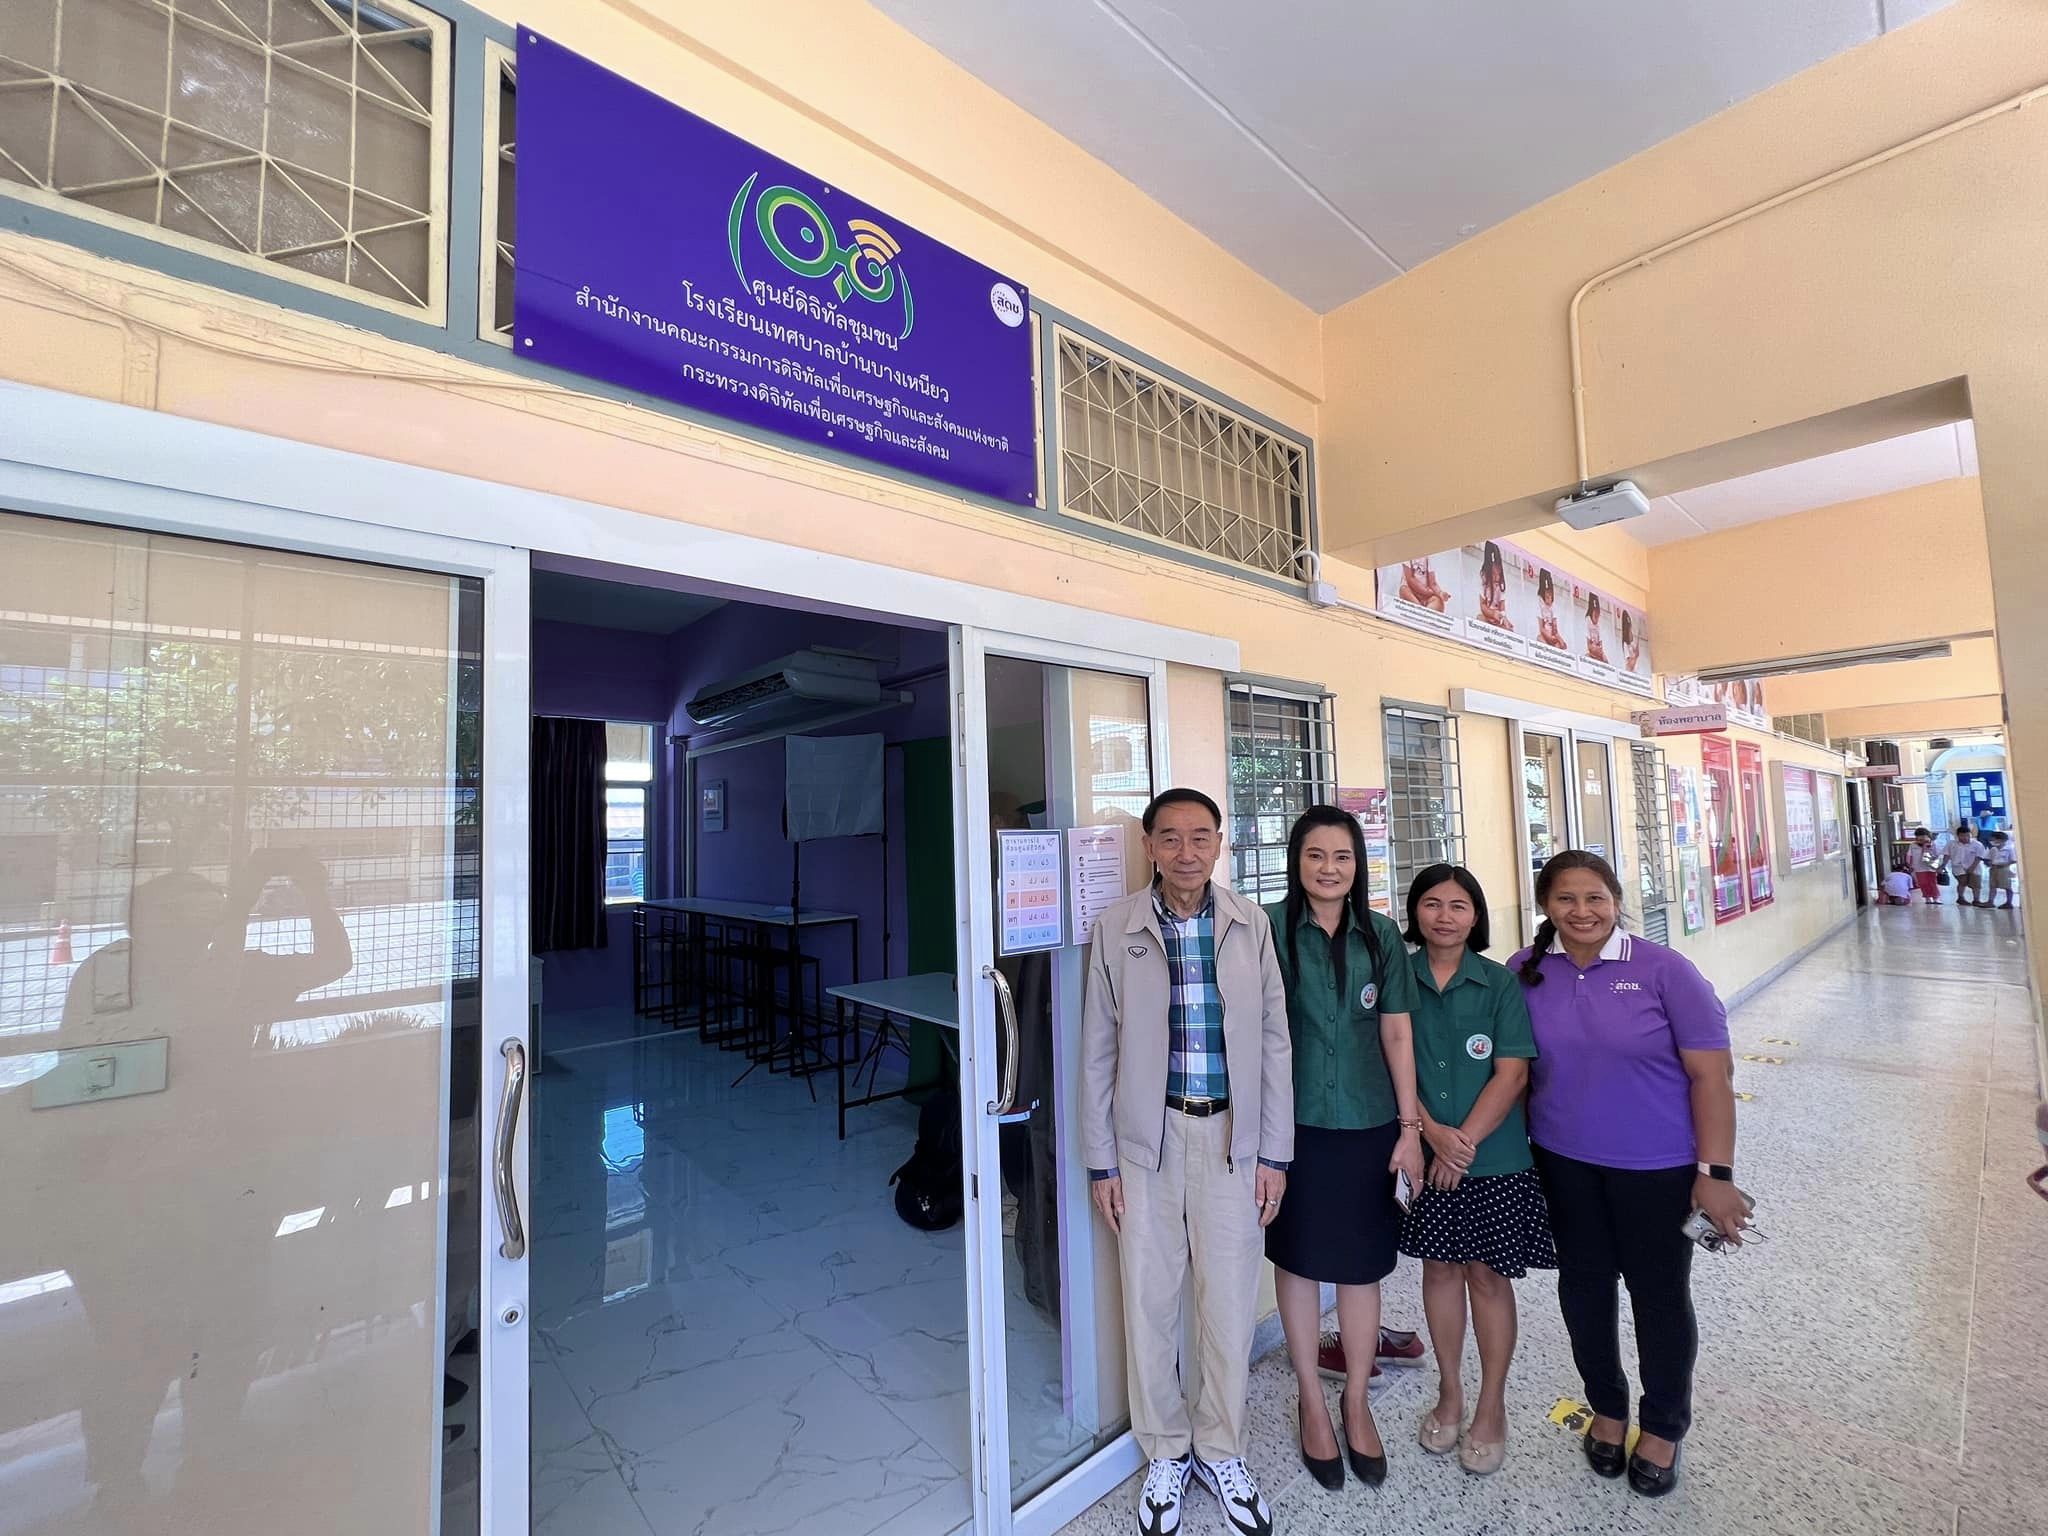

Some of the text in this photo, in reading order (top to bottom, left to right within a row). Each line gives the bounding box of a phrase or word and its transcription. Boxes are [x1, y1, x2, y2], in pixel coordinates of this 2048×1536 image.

[682, 280, 949, 403] โรงเรียนเทศบาลบ้านบางเหนียว
[753, 279, 898, 351] ศูนย์ดิจิทัลชุมชน
[576, 286, 1008, 452] สำนักงานคณะกรรมการดิจิทัลเพื่อเศรษฐกิจและสังคมแห่งชาติ
[683, 364, 949, 460] กระทรวงดิจิทัลเพื่อเศรษฐกิจและสังคม
[1659, 713, 1722, 726] ห้องพยาบาล
